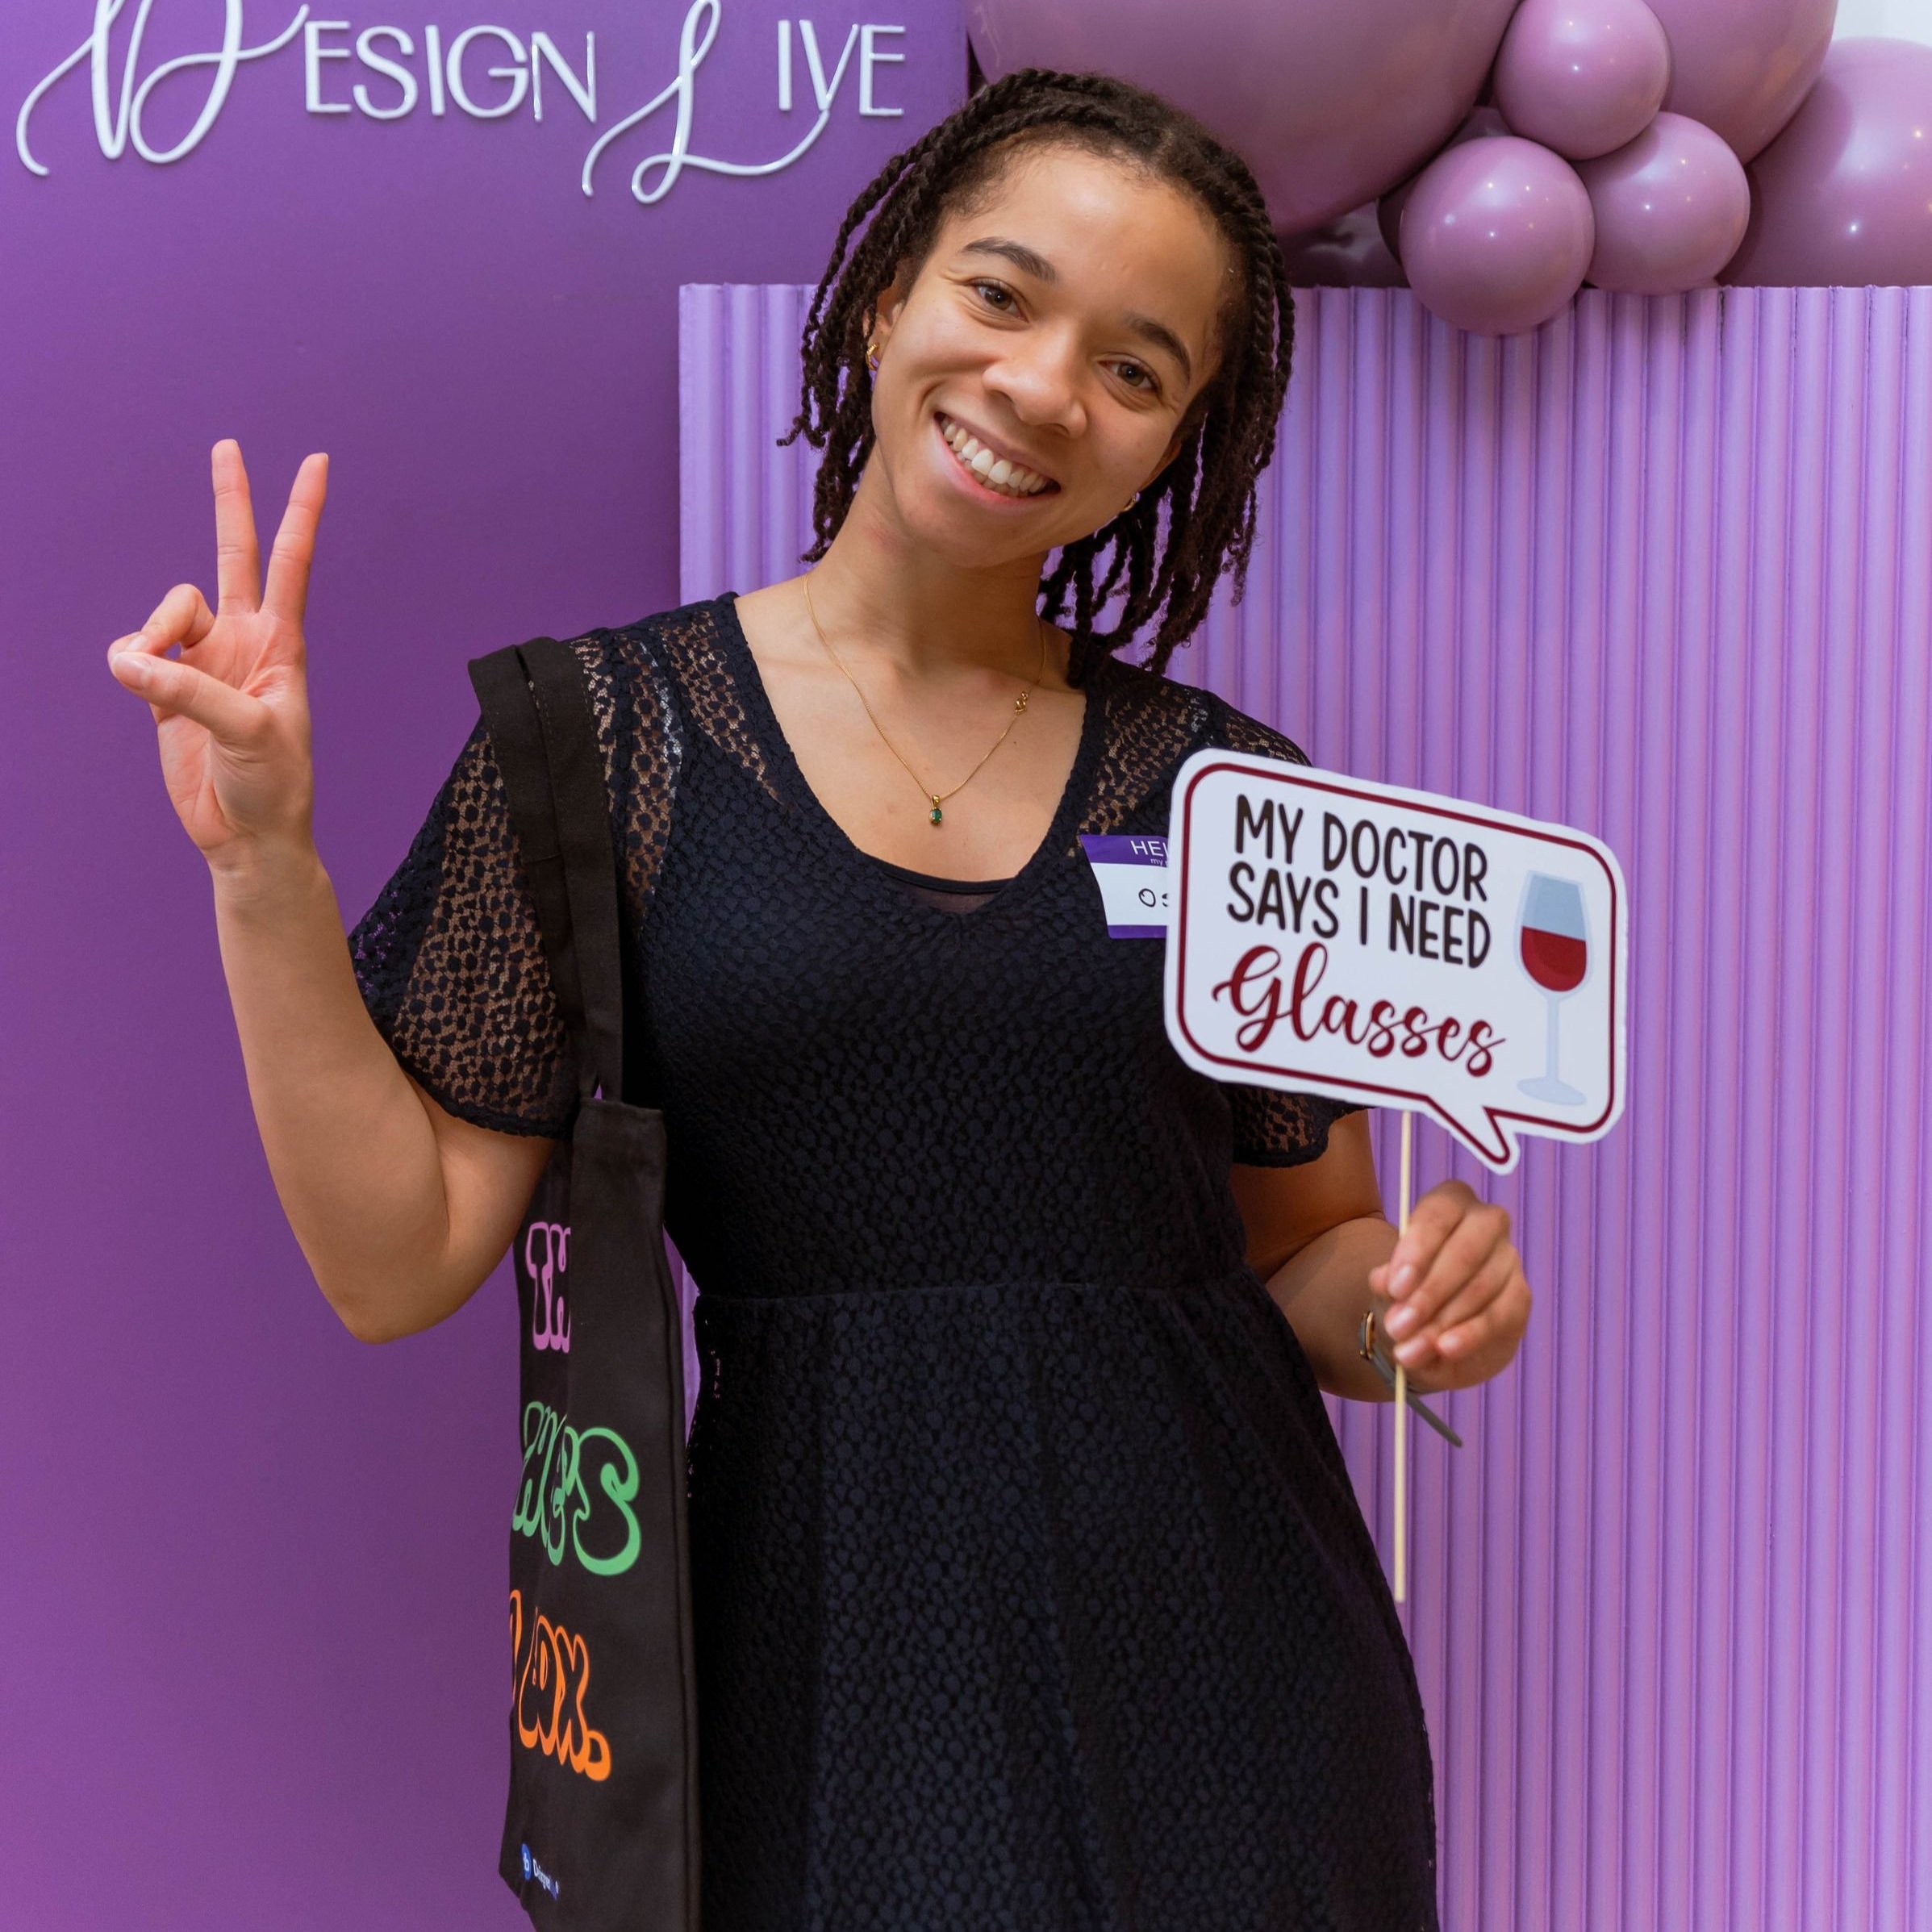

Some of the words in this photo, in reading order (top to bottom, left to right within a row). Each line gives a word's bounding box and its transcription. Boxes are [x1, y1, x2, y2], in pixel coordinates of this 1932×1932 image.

[16, 0, 596, 175] DESIGN
[582, 0, 904, 203] LIVE
[1235, 794, 1304, 865] MY
[1323, 812, 1488, 902] DOCTOR
[1228, 861, 1339, 939] SAYS
[1360, 886, 1368, 945] I
[1389, 892, 1491, 969] NEED
[1212, 941, 1506, 1079] Glasses
